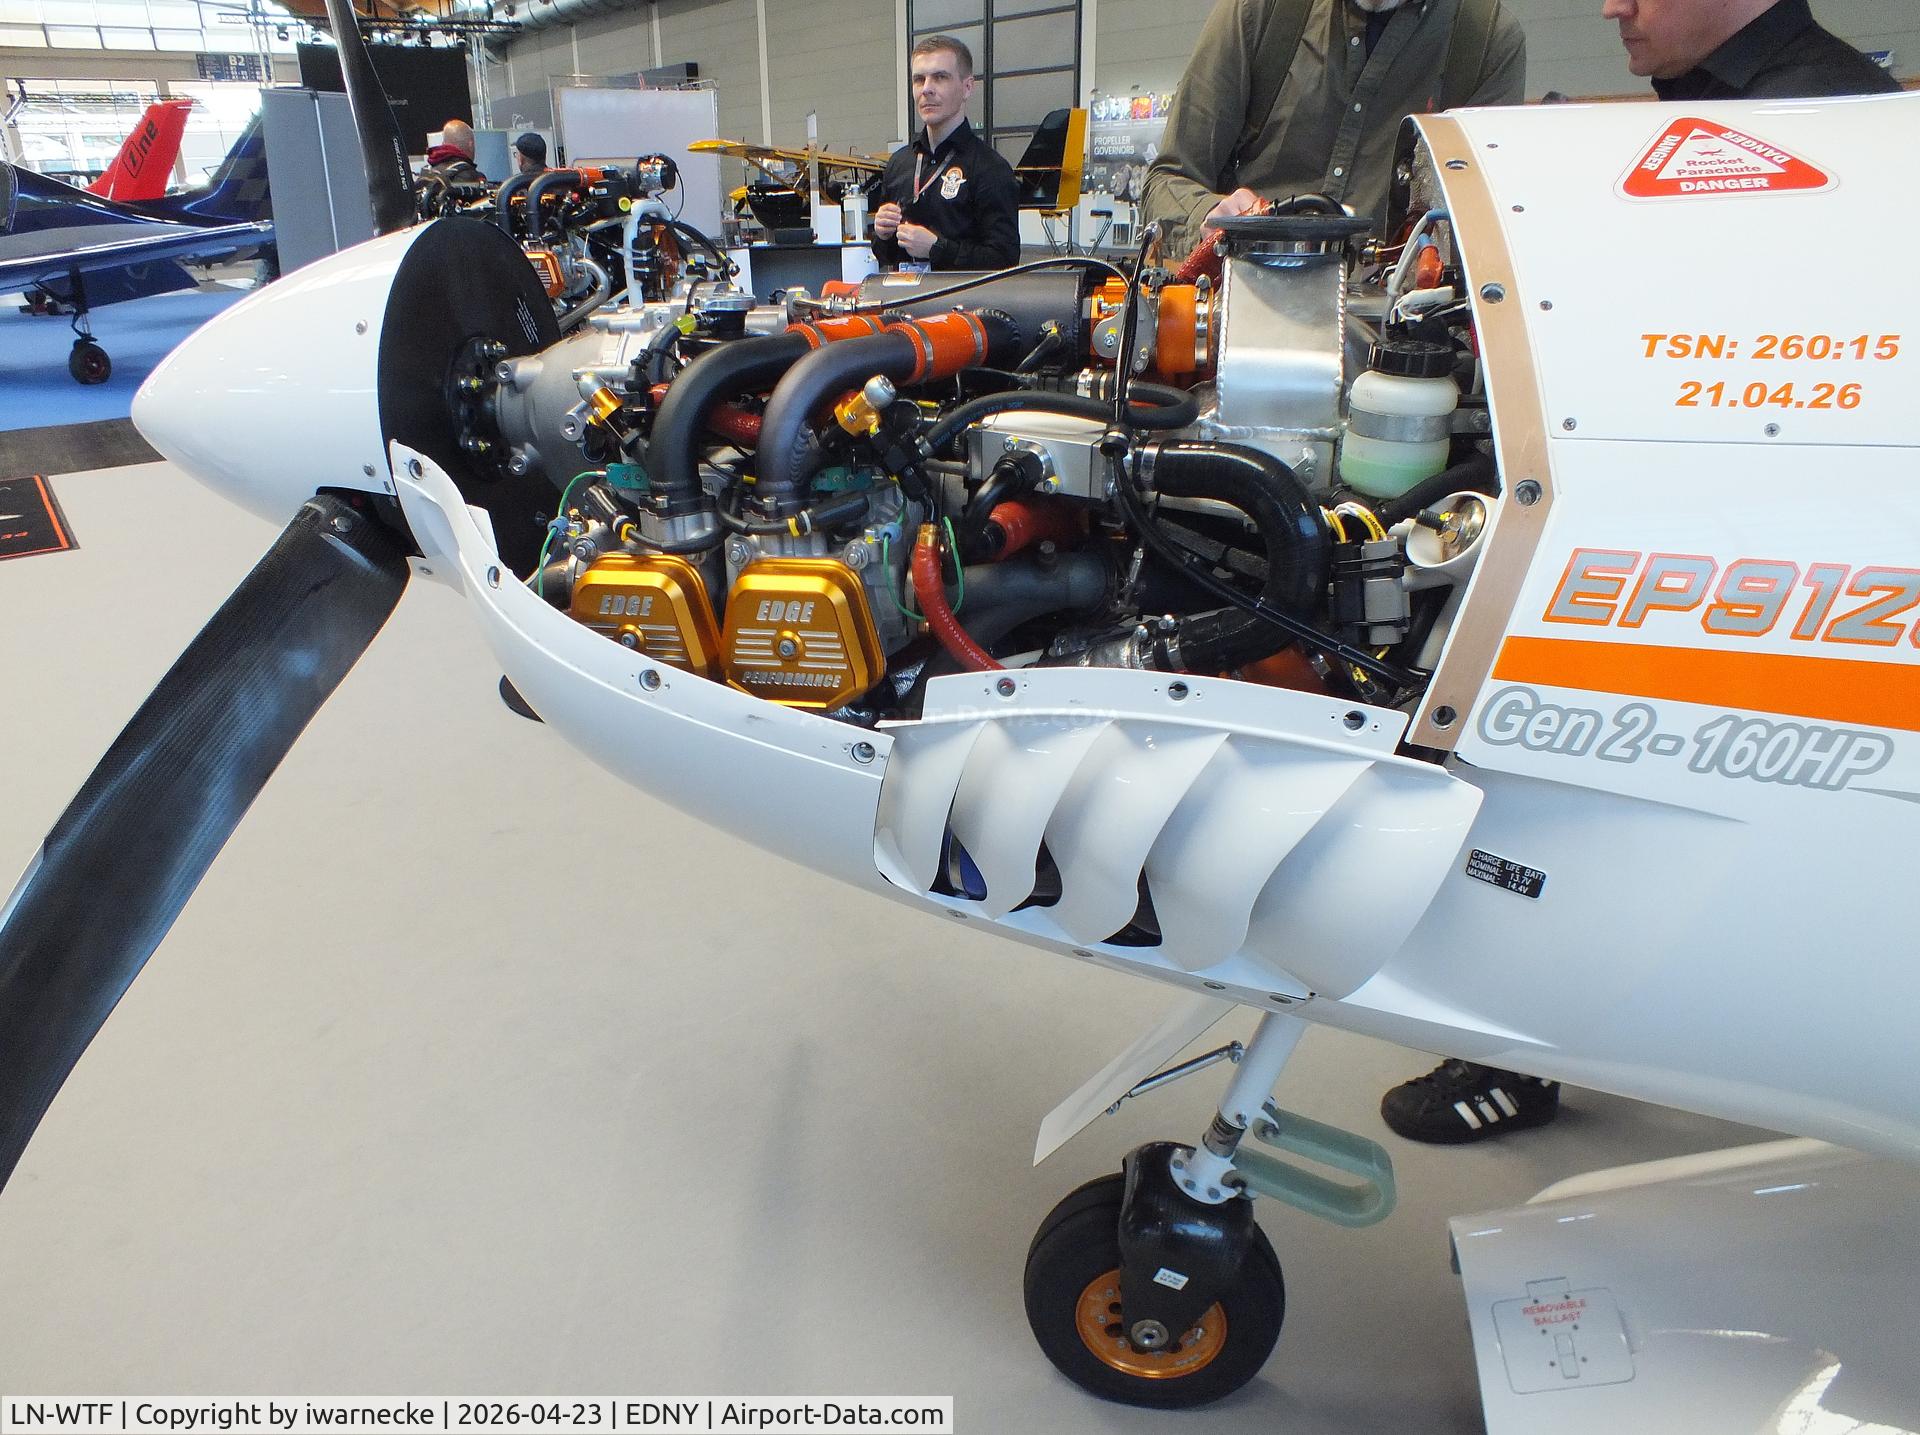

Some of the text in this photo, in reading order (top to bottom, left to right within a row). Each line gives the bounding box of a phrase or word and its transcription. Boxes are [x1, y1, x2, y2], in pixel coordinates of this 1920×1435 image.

[228, 55, 246, 66] B2
[1093, 145, 1135, 155] GOVERNORS
[1094, 135, 1131, 146] PROPELLER
[1719, 130, 1791, 165] DANGER
[1641, 134, 1682, 171] DANGER
[1686, 157, 1745, 167] Rocket
[1676, 165, 1761, 177] Parachute
[1680, 177, 1769, 192] DANGER
[1640, 334, 1901, 360] TSN: 260:15
[1675, 381, 1863, 410] 21.04.26
[599, 594, 654, 616] EDGE
[1542, 547, 1920, 649] EP912
[756, 600, 815, 623] EDGE
[742, 671, 842, 688] PERFORMANCE
[1477, 685, 1603, 757] Gen
[1469, 859, 1531, 886] NOMINAL: 13.7V
[1472, 850, 1503, 867] CHARGE
[1506, 862, 1521, 874] LIFE
[1467, 867, 1529, 894] MAXIMAL: 14.4V
[1522, 1299, 1586, 1315] REMOVABLE
[1534, 1311, 1581, 1326] BALLAST
